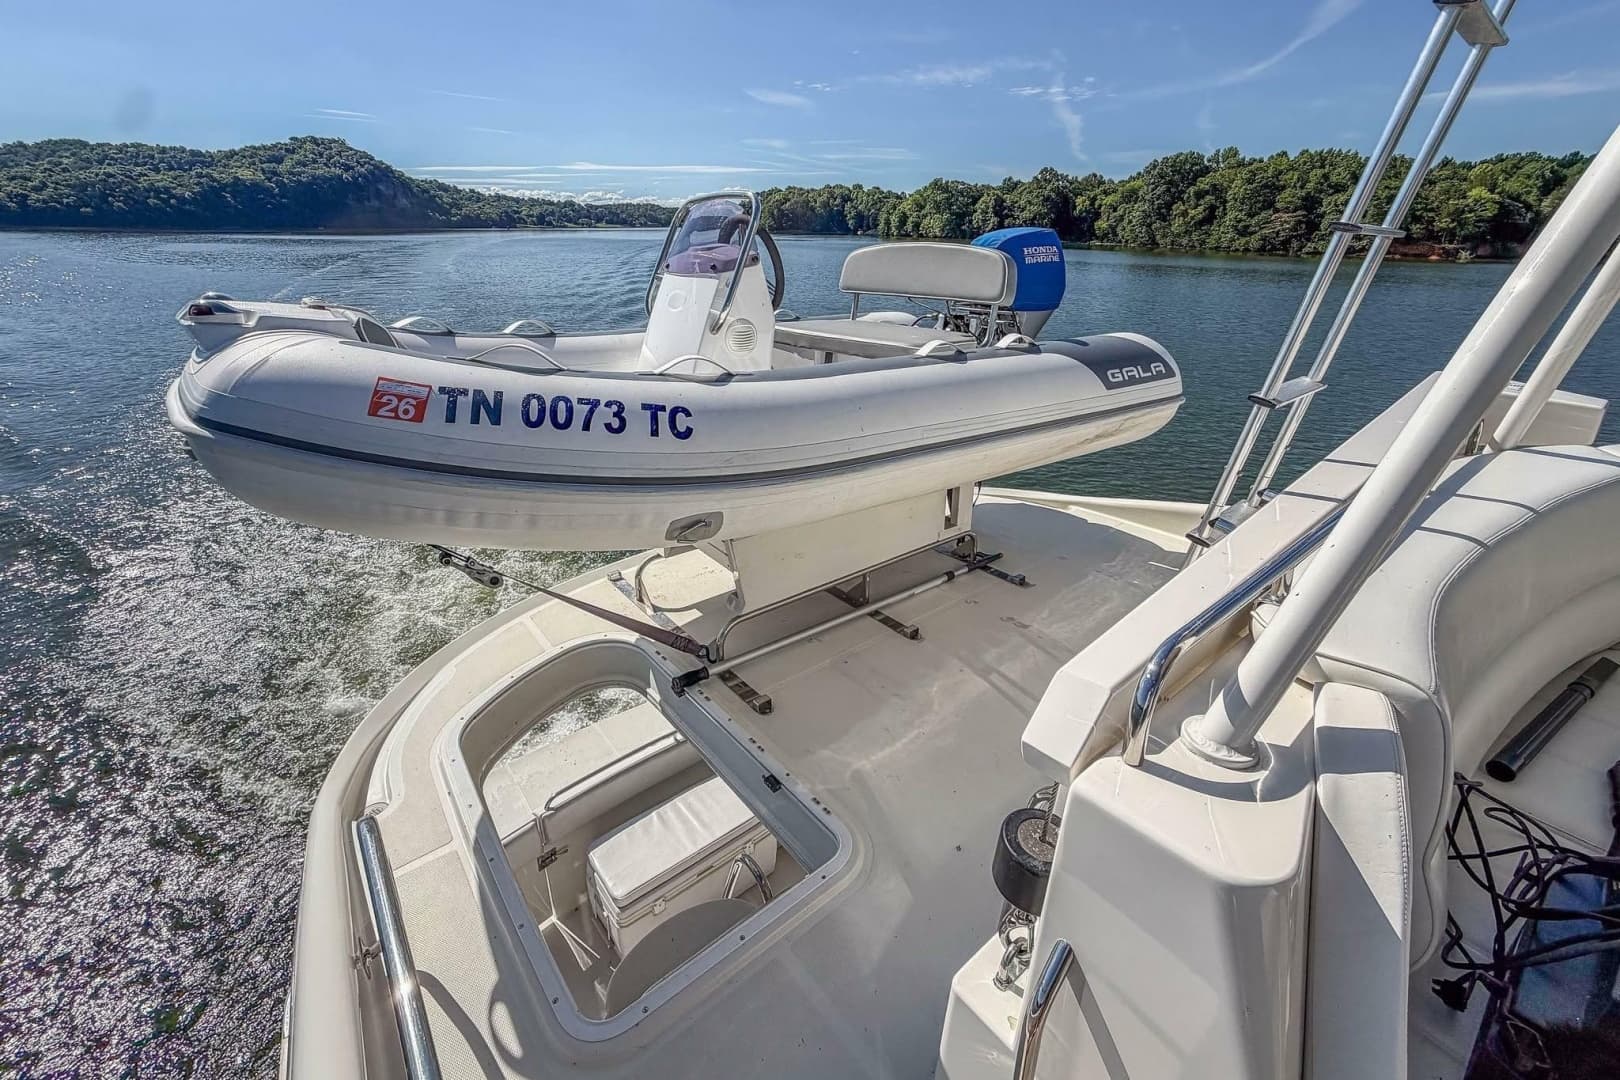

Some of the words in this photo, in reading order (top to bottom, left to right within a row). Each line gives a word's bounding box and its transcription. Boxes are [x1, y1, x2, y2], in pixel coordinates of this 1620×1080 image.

[1023, 246, 1058, 255] HONDA
[1025, 255, 1060, 264] MARINE
[1107, 362, 1166, 382] GALA
[377, 395, 416, 420] 26
[438, 386, 504, 426] TN
[521, 393, 627, 435] 0073
[641, 402, 694, 440] TC
